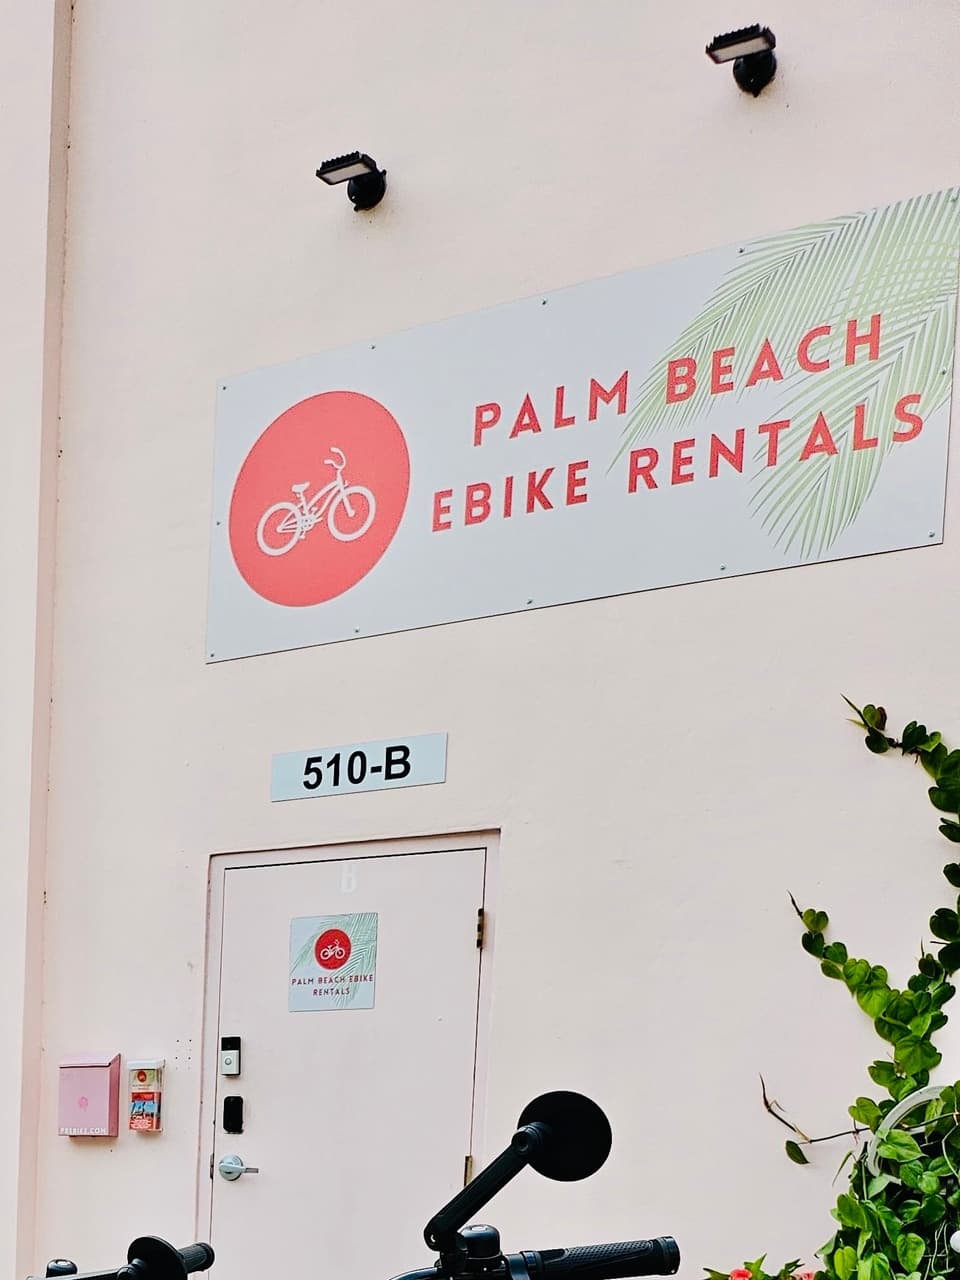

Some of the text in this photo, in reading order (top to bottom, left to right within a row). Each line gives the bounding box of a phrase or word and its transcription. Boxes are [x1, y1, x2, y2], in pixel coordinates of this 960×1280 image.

[473, 313, 883, 446] PALM BEACH
[431, 393, 925, 533] EBIKE RENTALS
[303, 745, 411, 790] 510-B
[291, 974, 374, 985] PALM BEACH EBIKE
[313, 987, 351, 996] RENTALS
